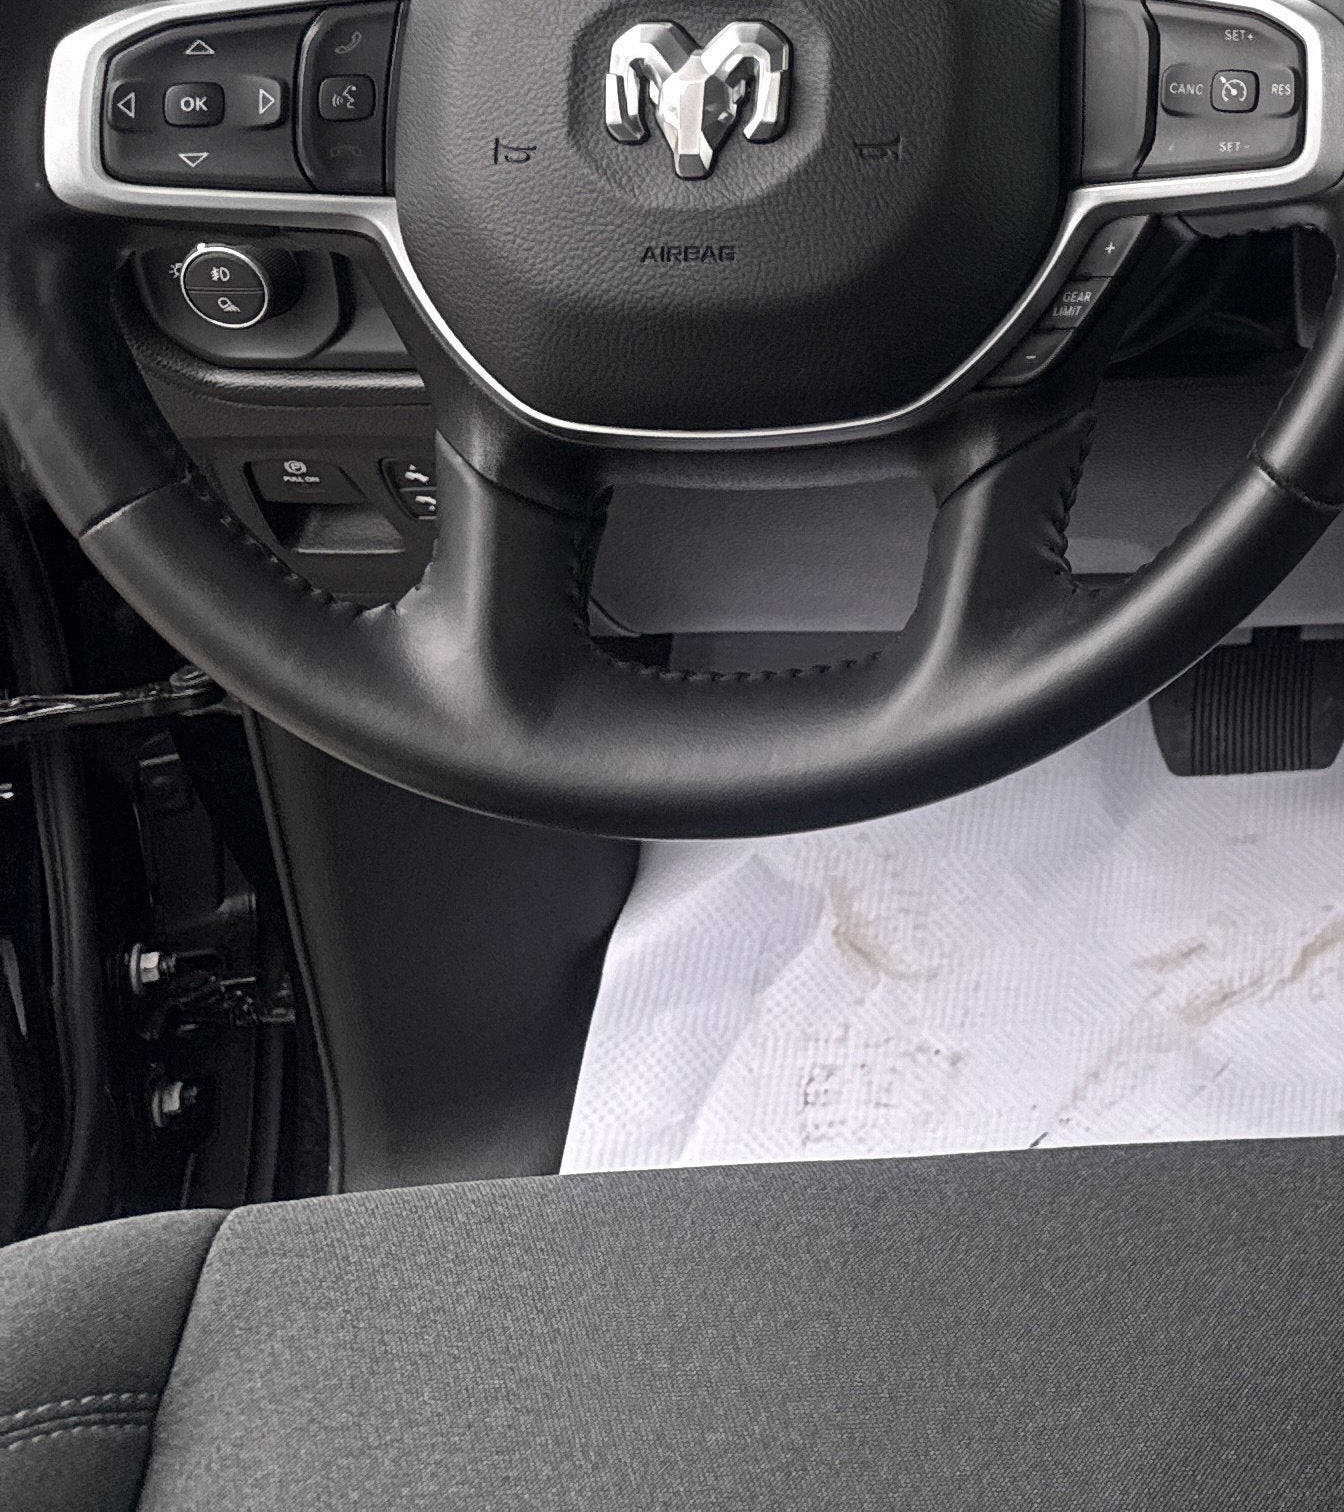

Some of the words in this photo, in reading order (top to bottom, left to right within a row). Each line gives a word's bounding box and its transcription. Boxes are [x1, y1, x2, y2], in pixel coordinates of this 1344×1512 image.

[1169, 82, 1204, 95] CANC
[1271, 83, 1291, 96] RES
[179, 95, 209, 114] OK
[640, 244, 737, 264] AIRBAG
[1062, 291, 1093, 303] GEAR
[1052, 305, 1083, 317] LIMIT
